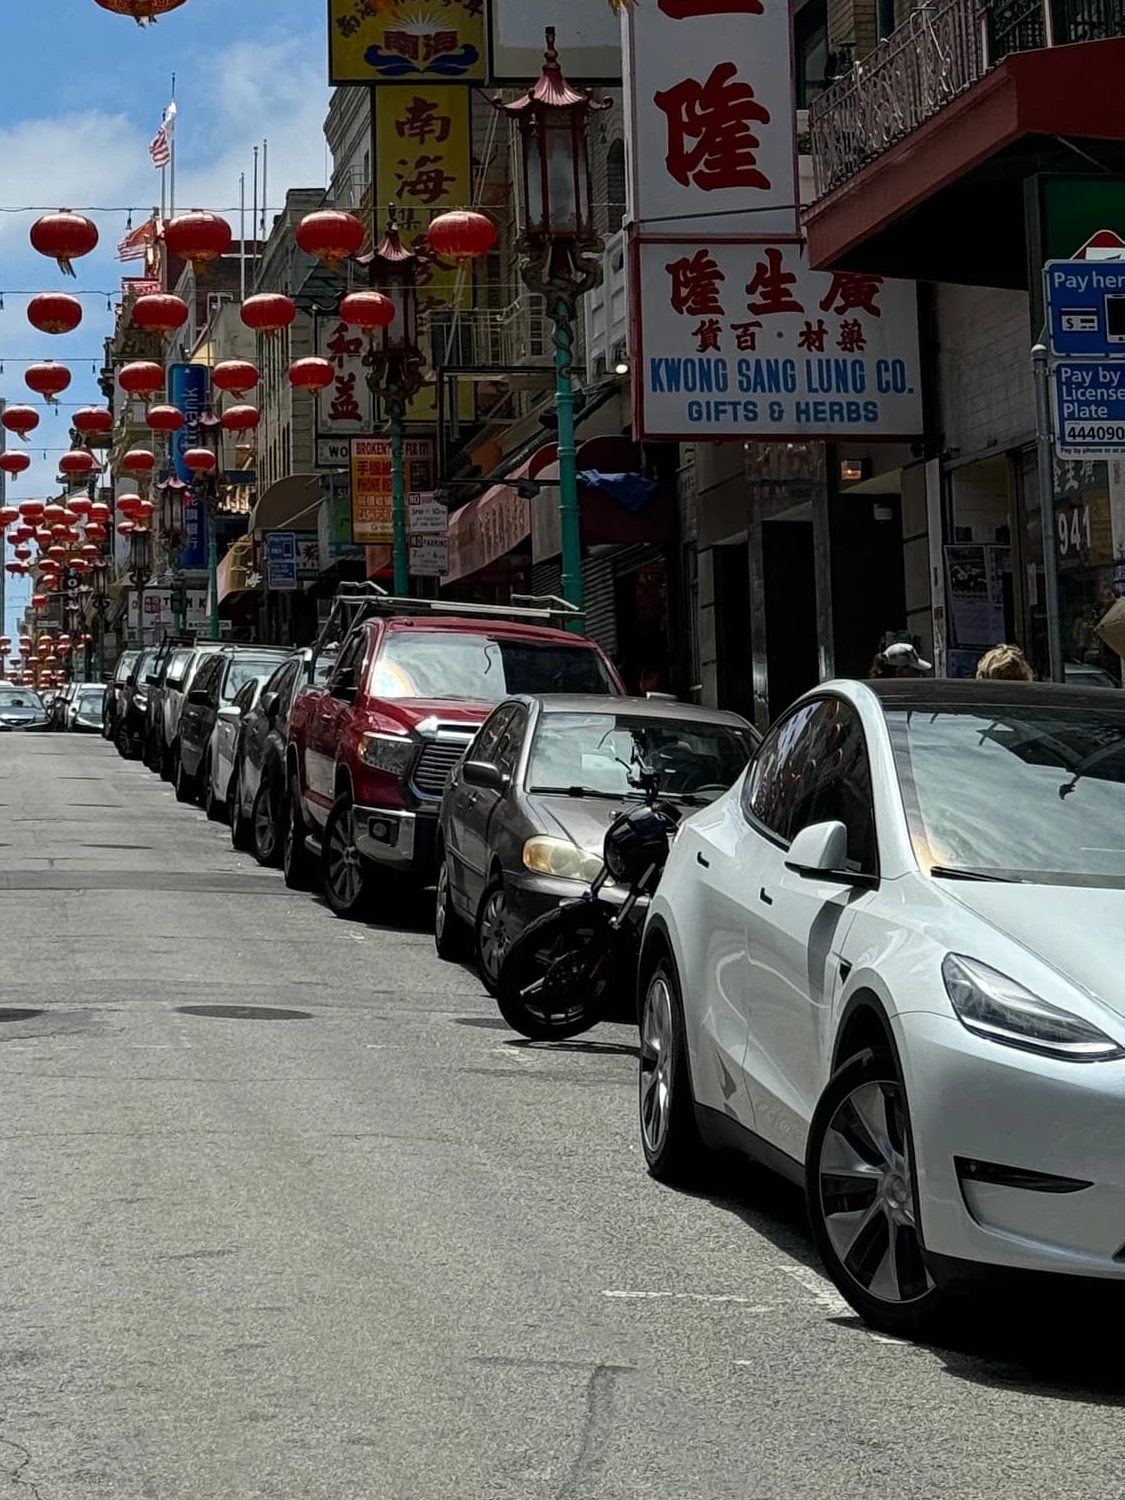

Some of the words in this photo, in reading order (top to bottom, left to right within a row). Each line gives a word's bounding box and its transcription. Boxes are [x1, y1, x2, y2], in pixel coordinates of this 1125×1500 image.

[395, 96, 456, 204] 南海
[1053, 272, 1089, 292] Pay
[650, 357, 728, 393] KWONG
[738, 358, 796, 393] SANG
[806, 358, 866, 393] LUNG
[877, 358, 915, 394] CO.
[1060, 367, 1092, 386] Pay
[1098, 366, 1121, 387] by
[1062, 384, 1125, 401] License
[687, 400, 759, 422] GIFTS
[769, 400, 784, 422] &
[795, 401, 879, 422] HERBS
[1062, 402, 1108, 418] Plate
[1058, 505, 1091, 554] 941
